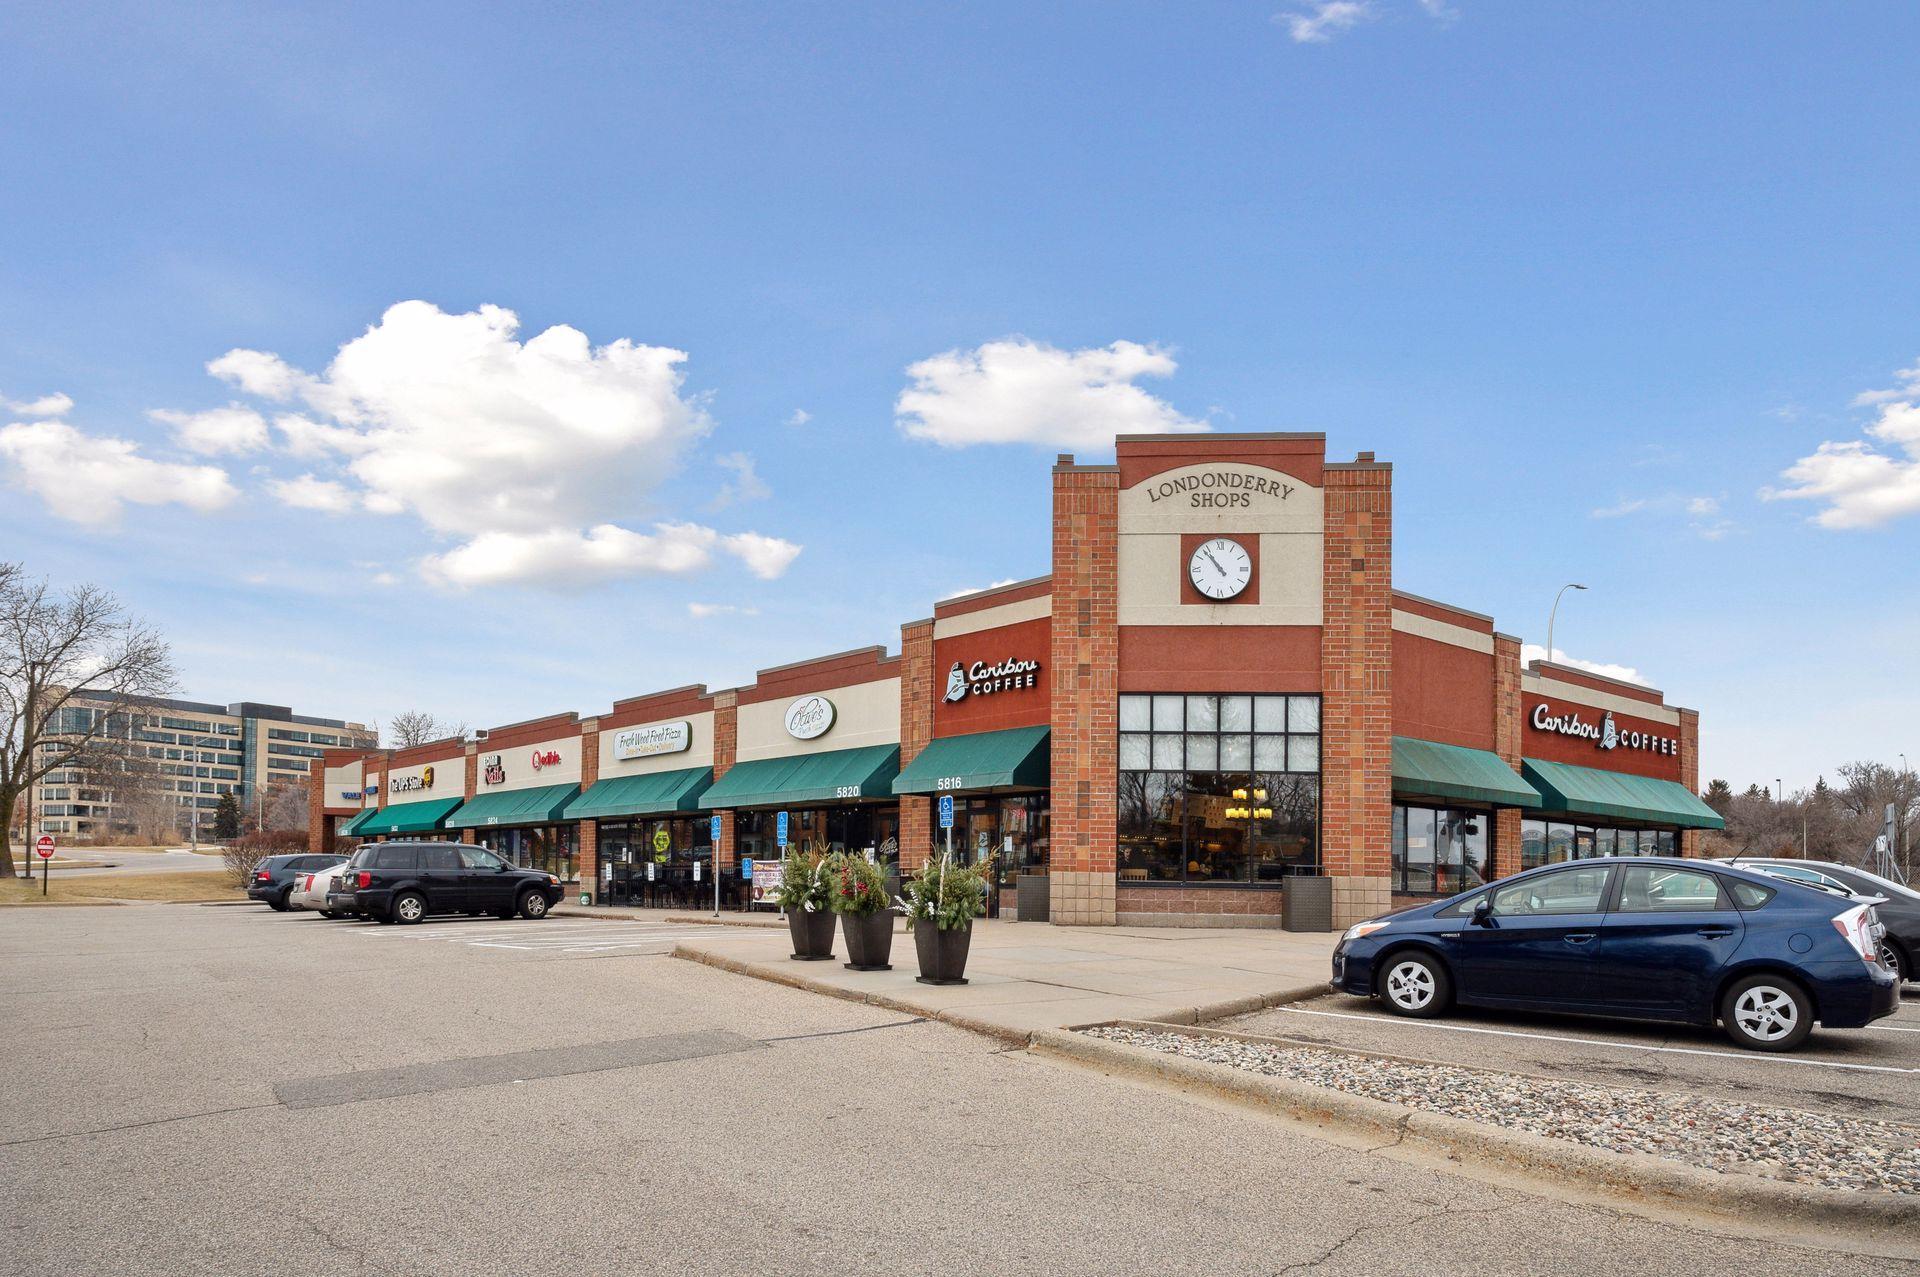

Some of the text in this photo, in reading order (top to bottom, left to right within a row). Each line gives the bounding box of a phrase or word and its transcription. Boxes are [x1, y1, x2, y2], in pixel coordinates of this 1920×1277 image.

[1146, 472, 1295, 503] LONDONDERRY
[1190, 492, 1251, 508] SHOPS
[968, 656, 1038, 681] Caribou
[972, 674, 1034, 695] COFFEE
[619, 732, 635, 749] Fresh
[634, 729, 651, 746] Wood
[650, 727, 665, 744] Fired
[664, 726, 681, 741] Pizza
[1533, 703, 1678, 756] Caribou COFFEE
[836, 785, 860, 798] 5820
[937, 776, 962, 790] 5816
[487, 816, 498, 825] 5824
